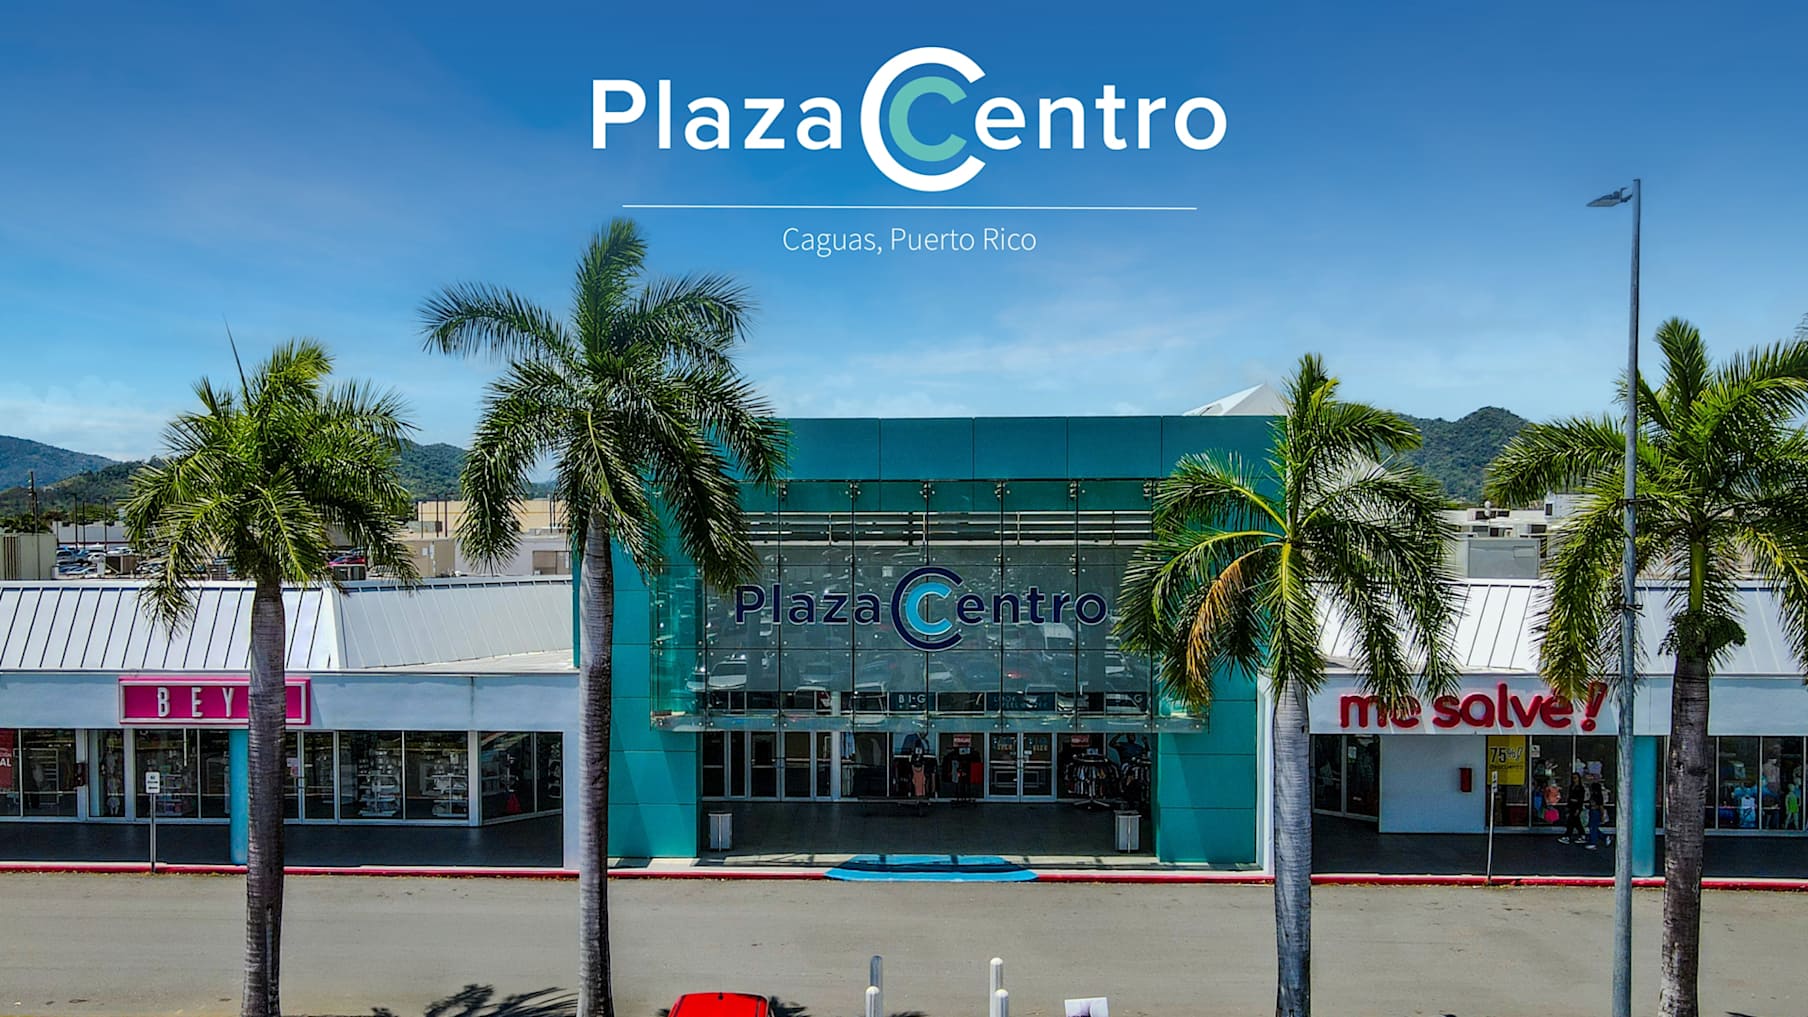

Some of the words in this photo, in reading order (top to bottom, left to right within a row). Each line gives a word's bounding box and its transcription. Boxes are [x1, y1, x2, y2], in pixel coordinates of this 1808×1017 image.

[735, 583, 881, 625] Plaza
[157, 687, 235, 718] BEY
[1340, 693, 1422, 728] me
